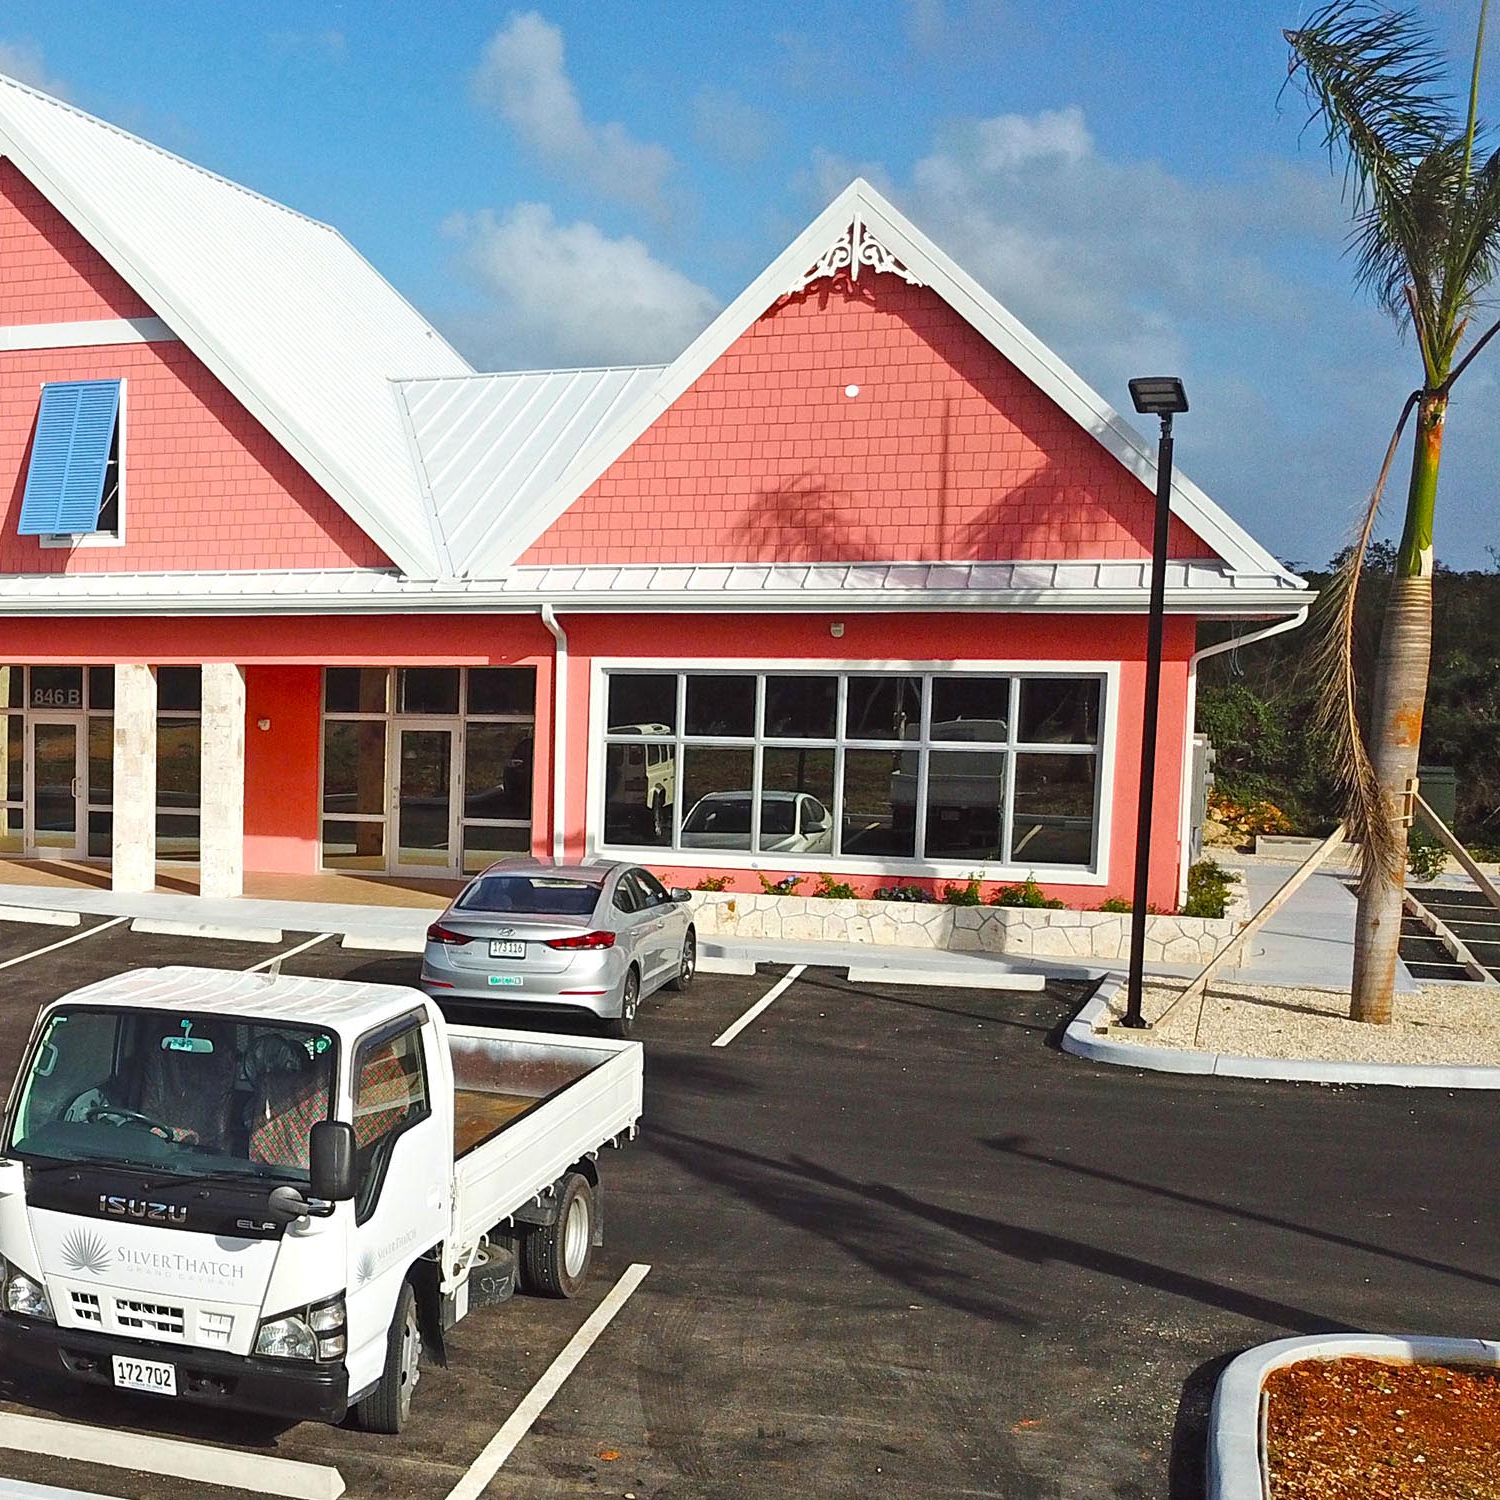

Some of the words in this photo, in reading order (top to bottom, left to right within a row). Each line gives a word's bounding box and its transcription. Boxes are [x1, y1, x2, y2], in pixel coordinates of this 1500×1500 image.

[34, 688, 64, 704] 846
[68, 689, 80, 704] B
[100, 1195, 187, 1223] ISUZU
[237, 1219, 276, 1230] ELF
